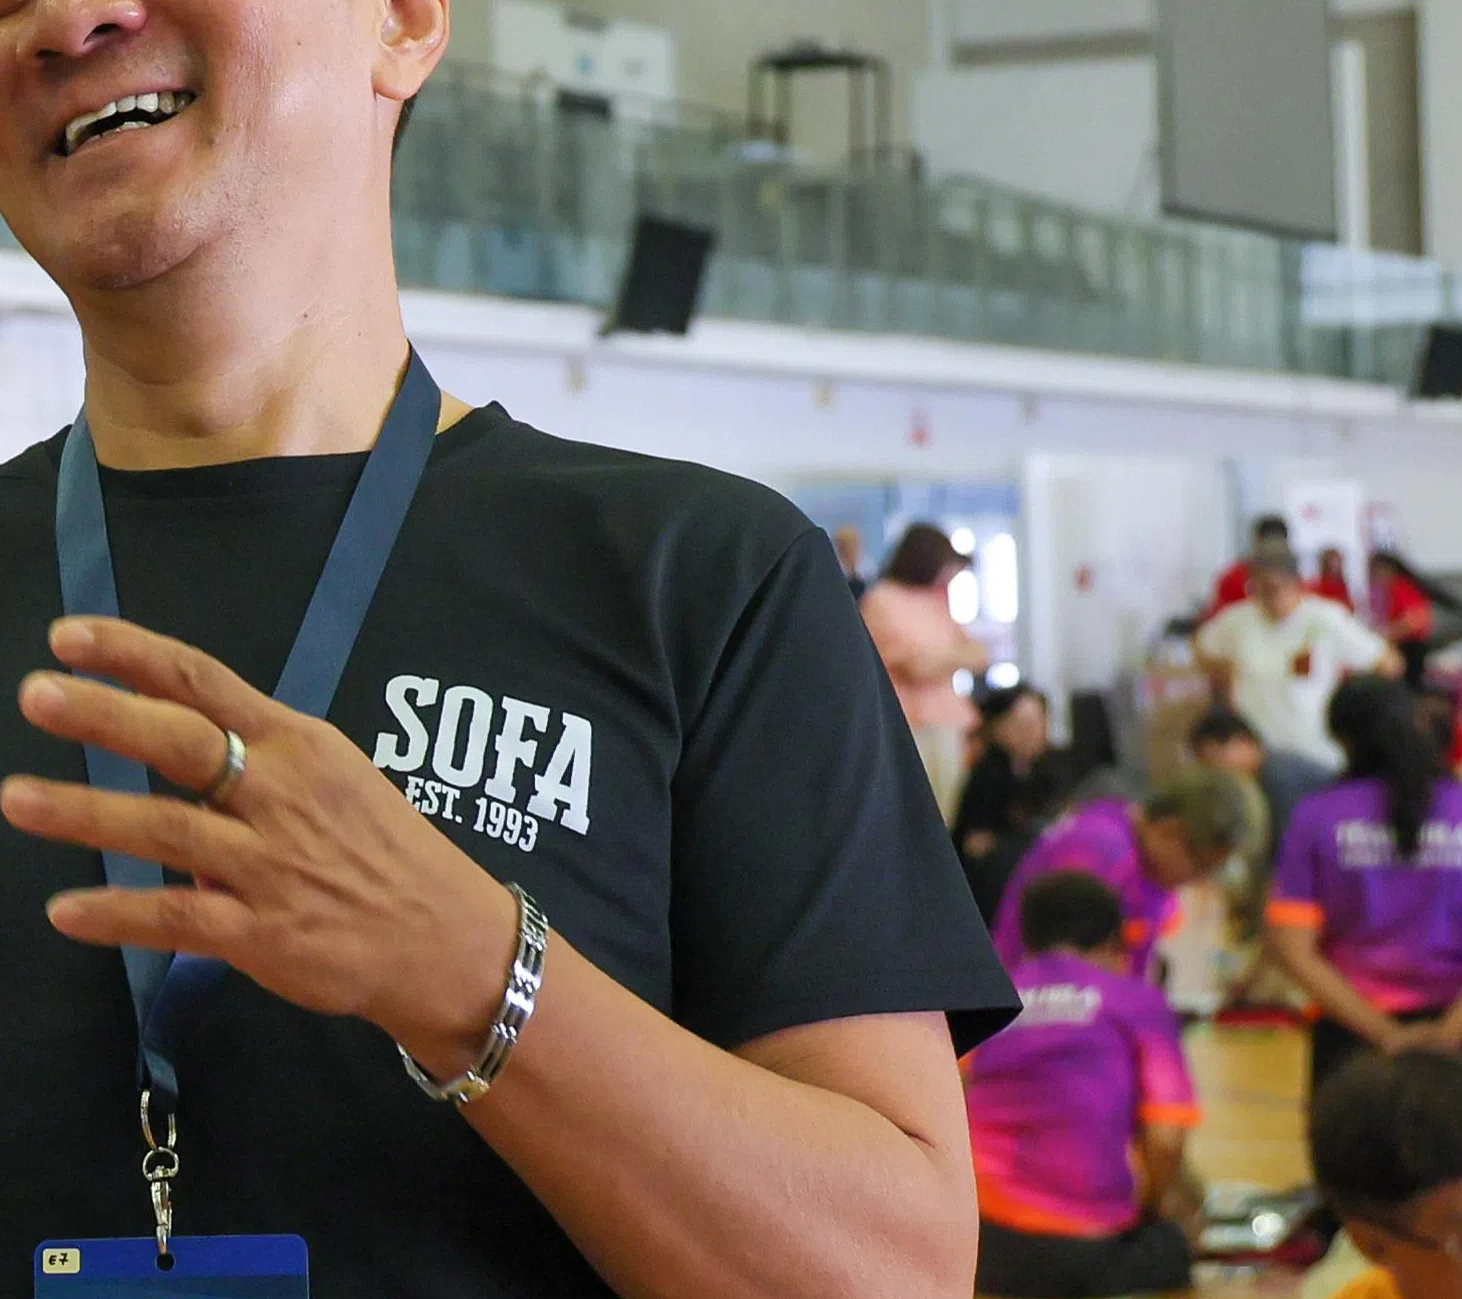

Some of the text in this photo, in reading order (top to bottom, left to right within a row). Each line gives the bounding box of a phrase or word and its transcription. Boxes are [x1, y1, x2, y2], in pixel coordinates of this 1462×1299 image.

[373, 675, 594, 836] SOFA
[404, 775, 539, 853] EST. 1993
